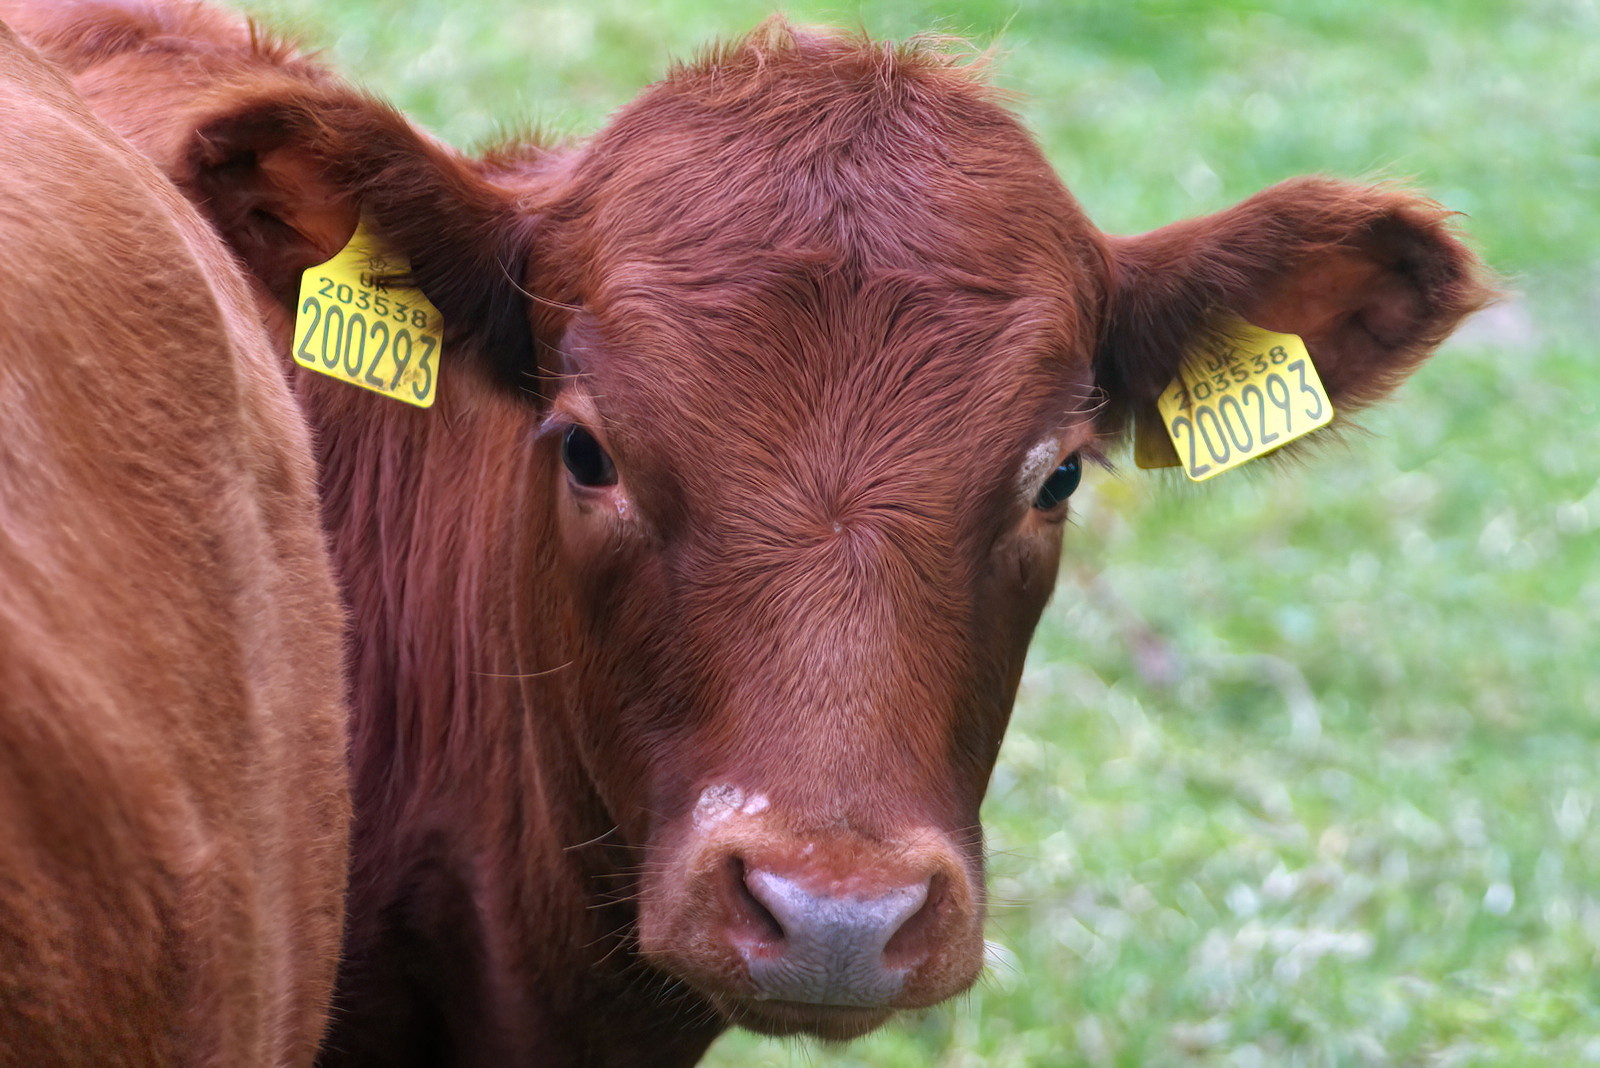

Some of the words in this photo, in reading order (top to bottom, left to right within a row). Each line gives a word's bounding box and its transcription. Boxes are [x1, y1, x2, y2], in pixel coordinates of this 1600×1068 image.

[318, 277, 427, 329] 203538
[360, 272, 389, 295] UK
[297, 296, 437, 401] 200293
[1173, 345, 1289, 411] 203538
[1171, 359, 1323, 477] 200293
